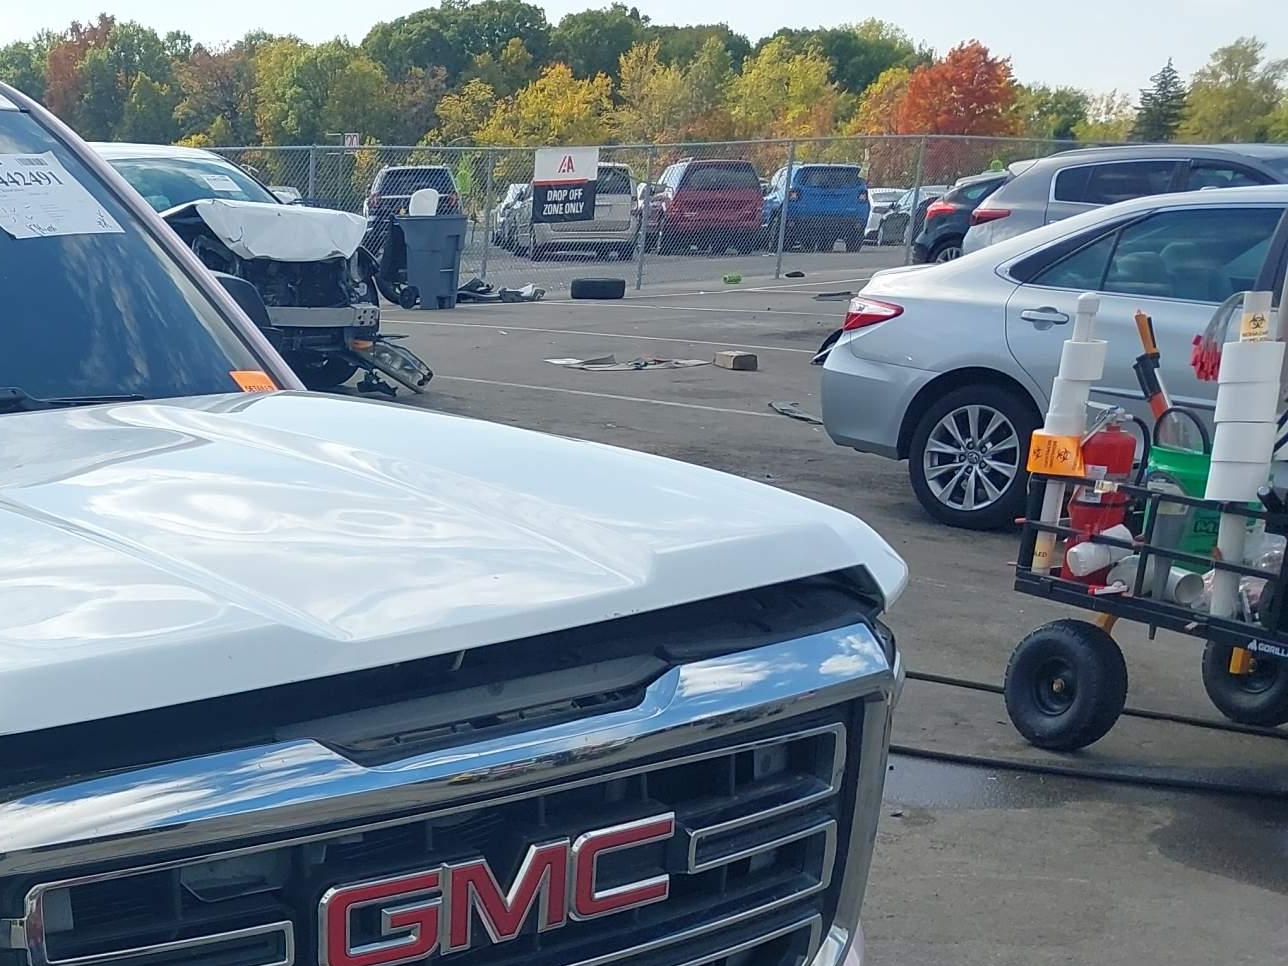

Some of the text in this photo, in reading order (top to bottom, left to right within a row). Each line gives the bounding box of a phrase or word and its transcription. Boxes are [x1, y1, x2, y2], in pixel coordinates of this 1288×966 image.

[547, 189, 583, 201] DROP OFF
[543, 202, 584, 215] ZONE ONLY
[1258, 643, 1288, 657] GORILL
